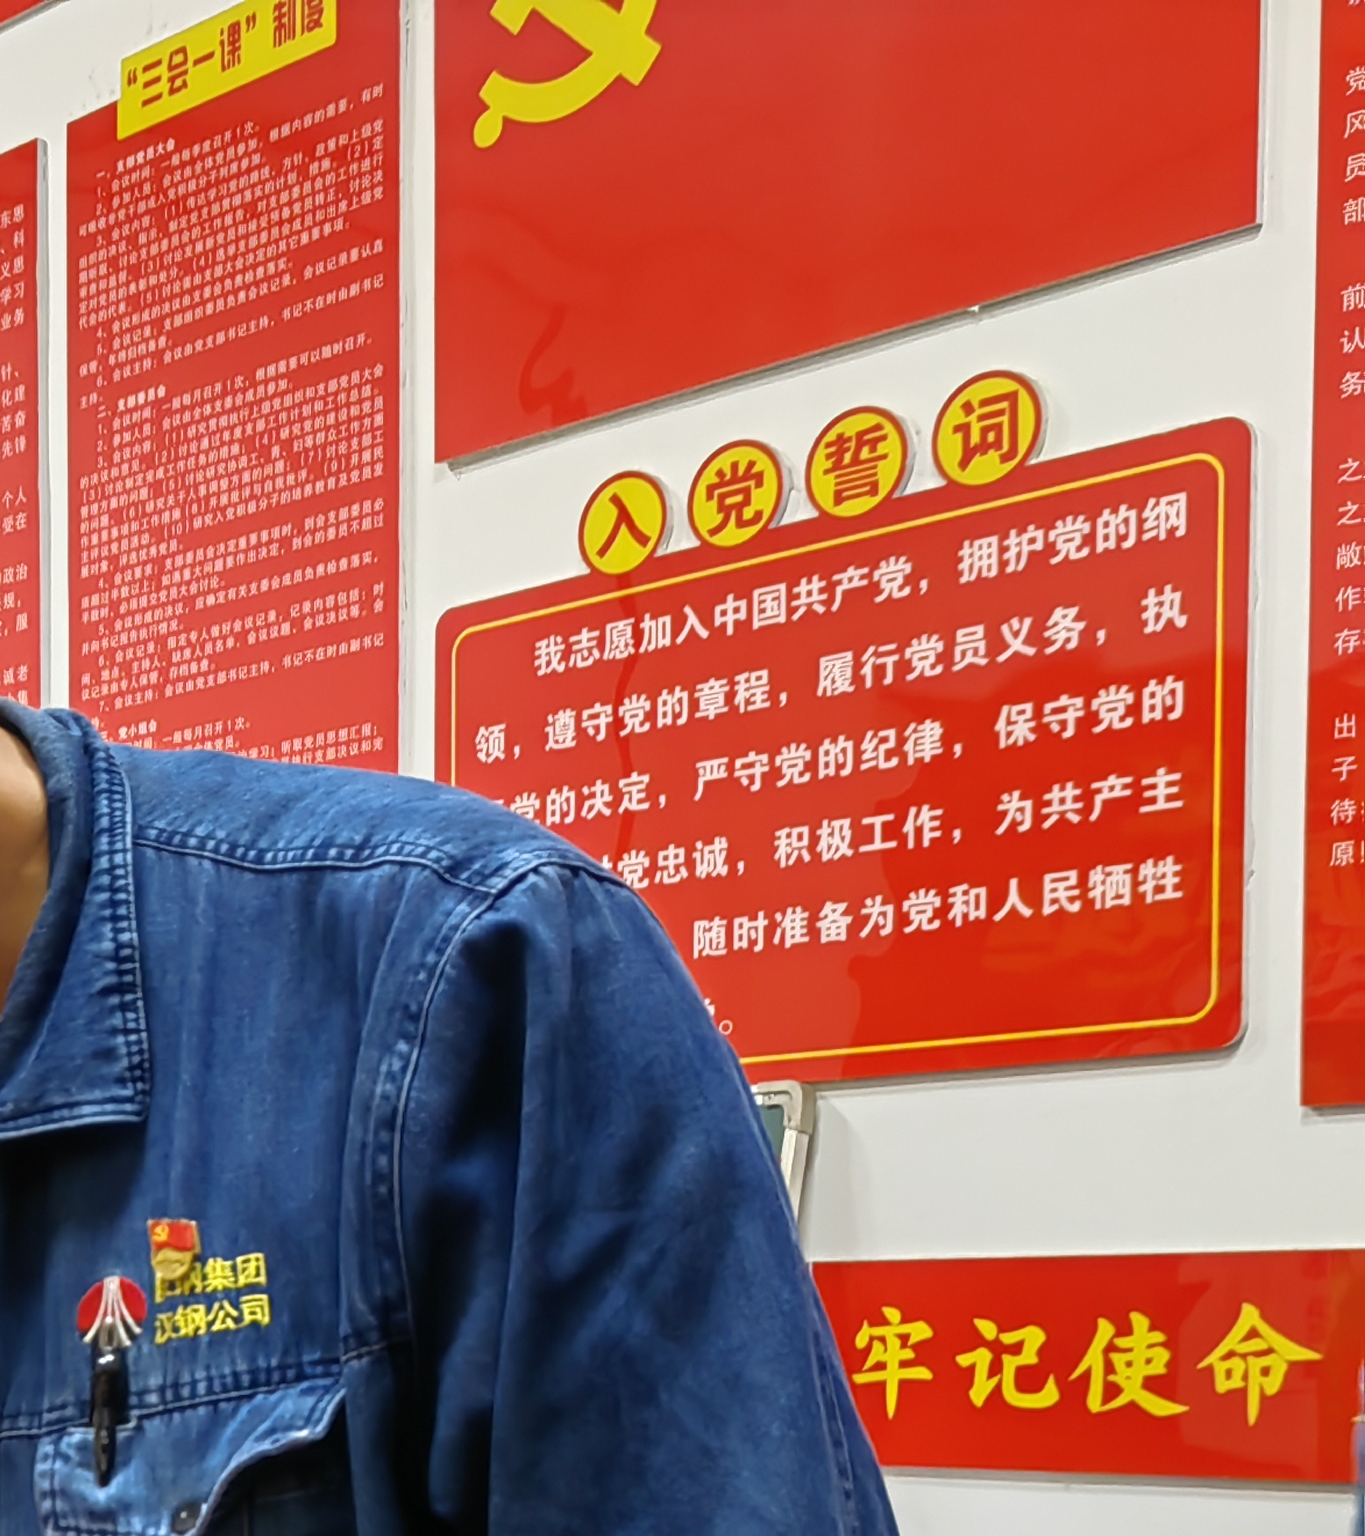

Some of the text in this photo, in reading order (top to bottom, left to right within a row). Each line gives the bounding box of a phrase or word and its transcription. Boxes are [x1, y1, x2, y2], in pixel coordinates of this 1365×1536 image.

[605, 388, 1021, 557] 入党誓词
[534, 490, 1188, 678] 我志愿加入中国共产党，拥护党的纲
[1335, 585, 1365, 613] 作
[1333, 627, 1365, 657] 存
[475, 582, 1188, 765] 领，遵守党的章程，履行党员义务，执
[1330, 798, 1365, 826] 待
[1329, 838, 1365, 868] 原
[693, 854, 1185, 960] 随时准备为党和人民牺牲
[155, 1253, 268, 1304] 集团
[155, 1293, 271, 1345] 汉钢公司
[852, 1301, 1323, 1427] 牢记使命
